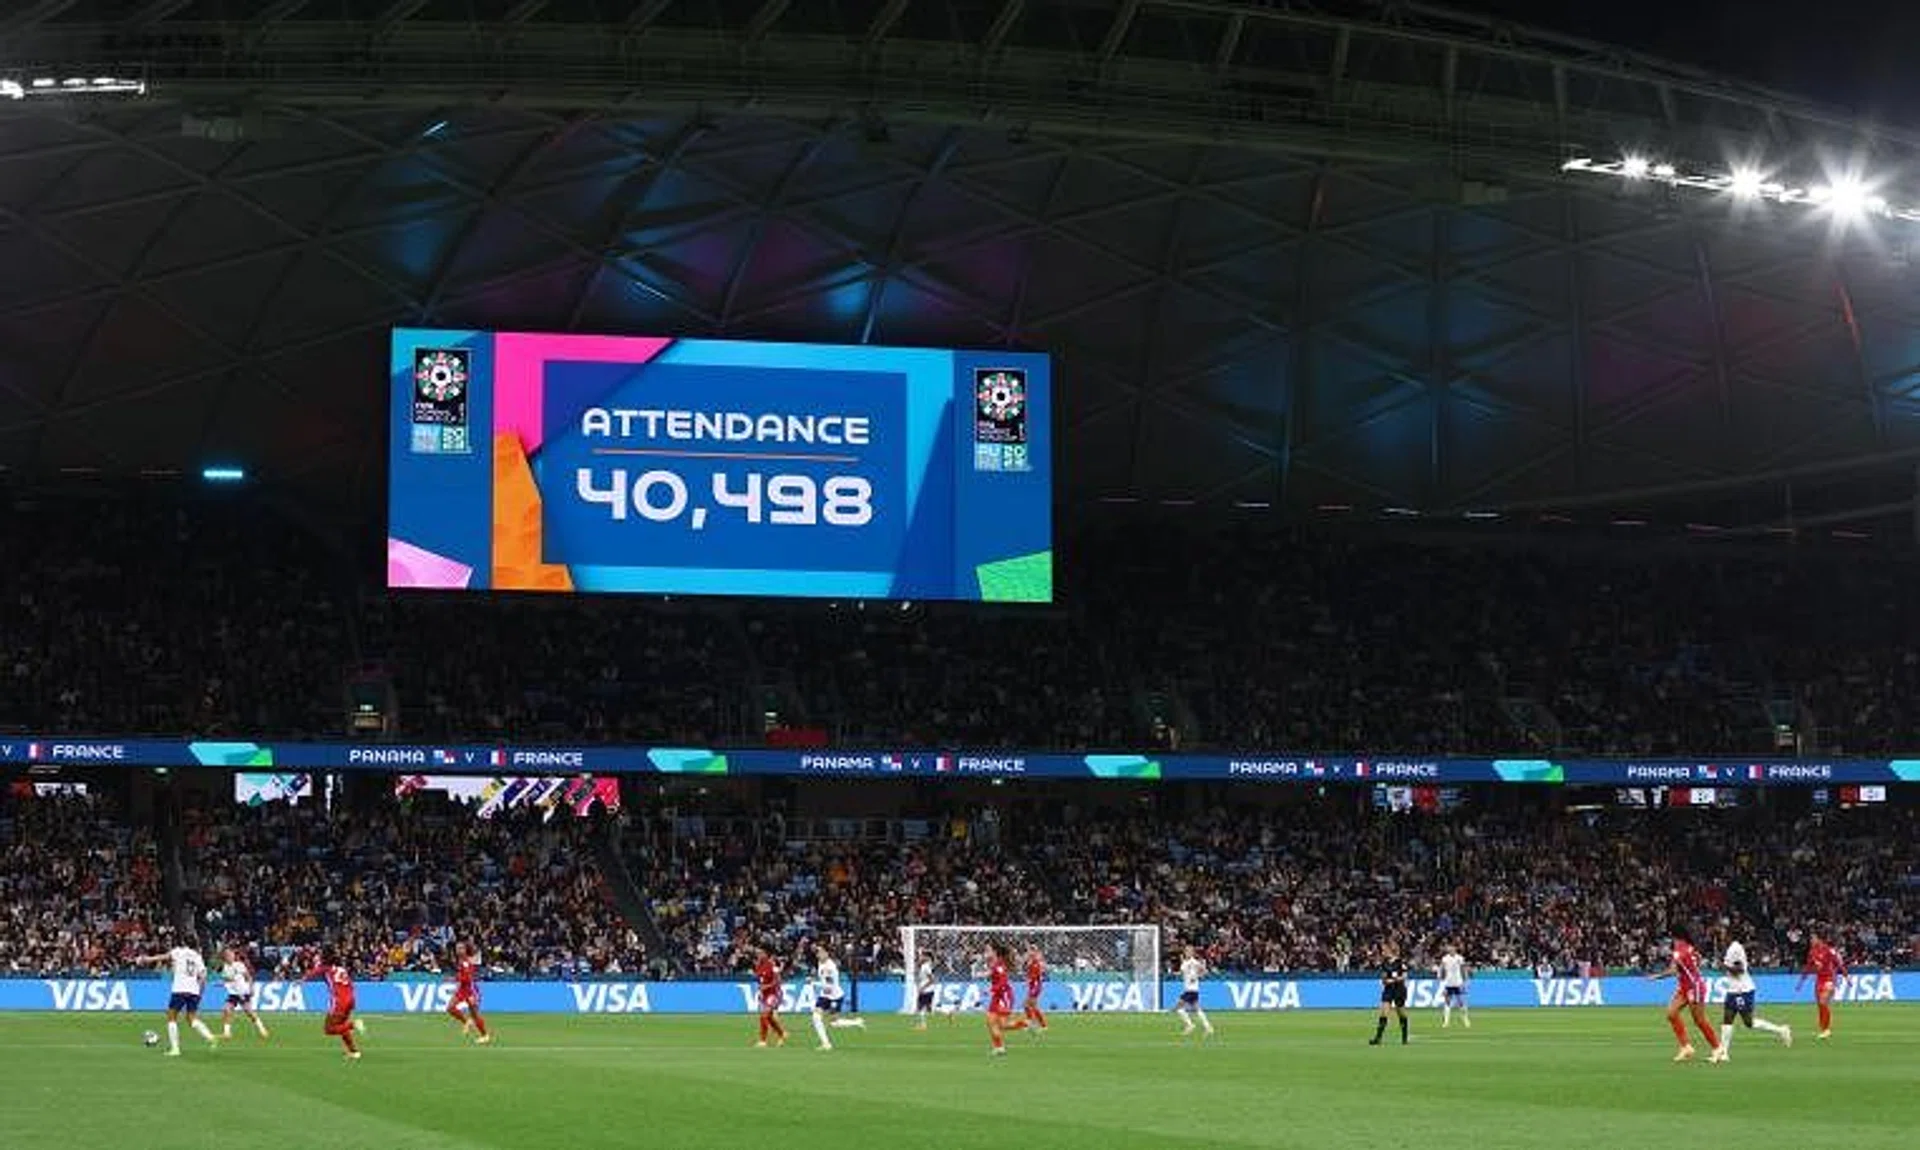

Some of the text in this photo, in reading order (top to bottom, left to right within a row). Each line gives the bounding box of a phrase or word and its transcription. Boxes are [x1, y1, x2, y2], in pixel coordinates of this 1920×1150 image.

[582, 407, 869, 445] ATTENDANCE
[577, 468, 873, 530] 40,498
[52, 744, 123, 759] FRANCE
[349, 750, 424, 763] PANAMA
[513, 752, 583, 766] FRANCE
[801, 756, 873, 769] PANAMA
[958, 759, 1025, 771] FRANCE
[1230, 762, 1297, 774] PANAMA
[1376, 764, 1438, 776] FRANCE
[1627, 765, 1690, 777] PANAMA
[1769, 766, 1831, 778] FRANCE
[46, 980, 131, 1010] VISA
[236, 982, 305, 1010] ISA
[396, 983, 466, 1012] VIS
[567, 983, 650, 1012] VISA
[736, 984, 815, 1012] VSA
[931, 983, 981, 1011] ISA
[1066, 982, 1143, 1010] VISA
[1226, 981, 1301, 1008] VISA
[1530, 979, 1604, 1005] VISA
